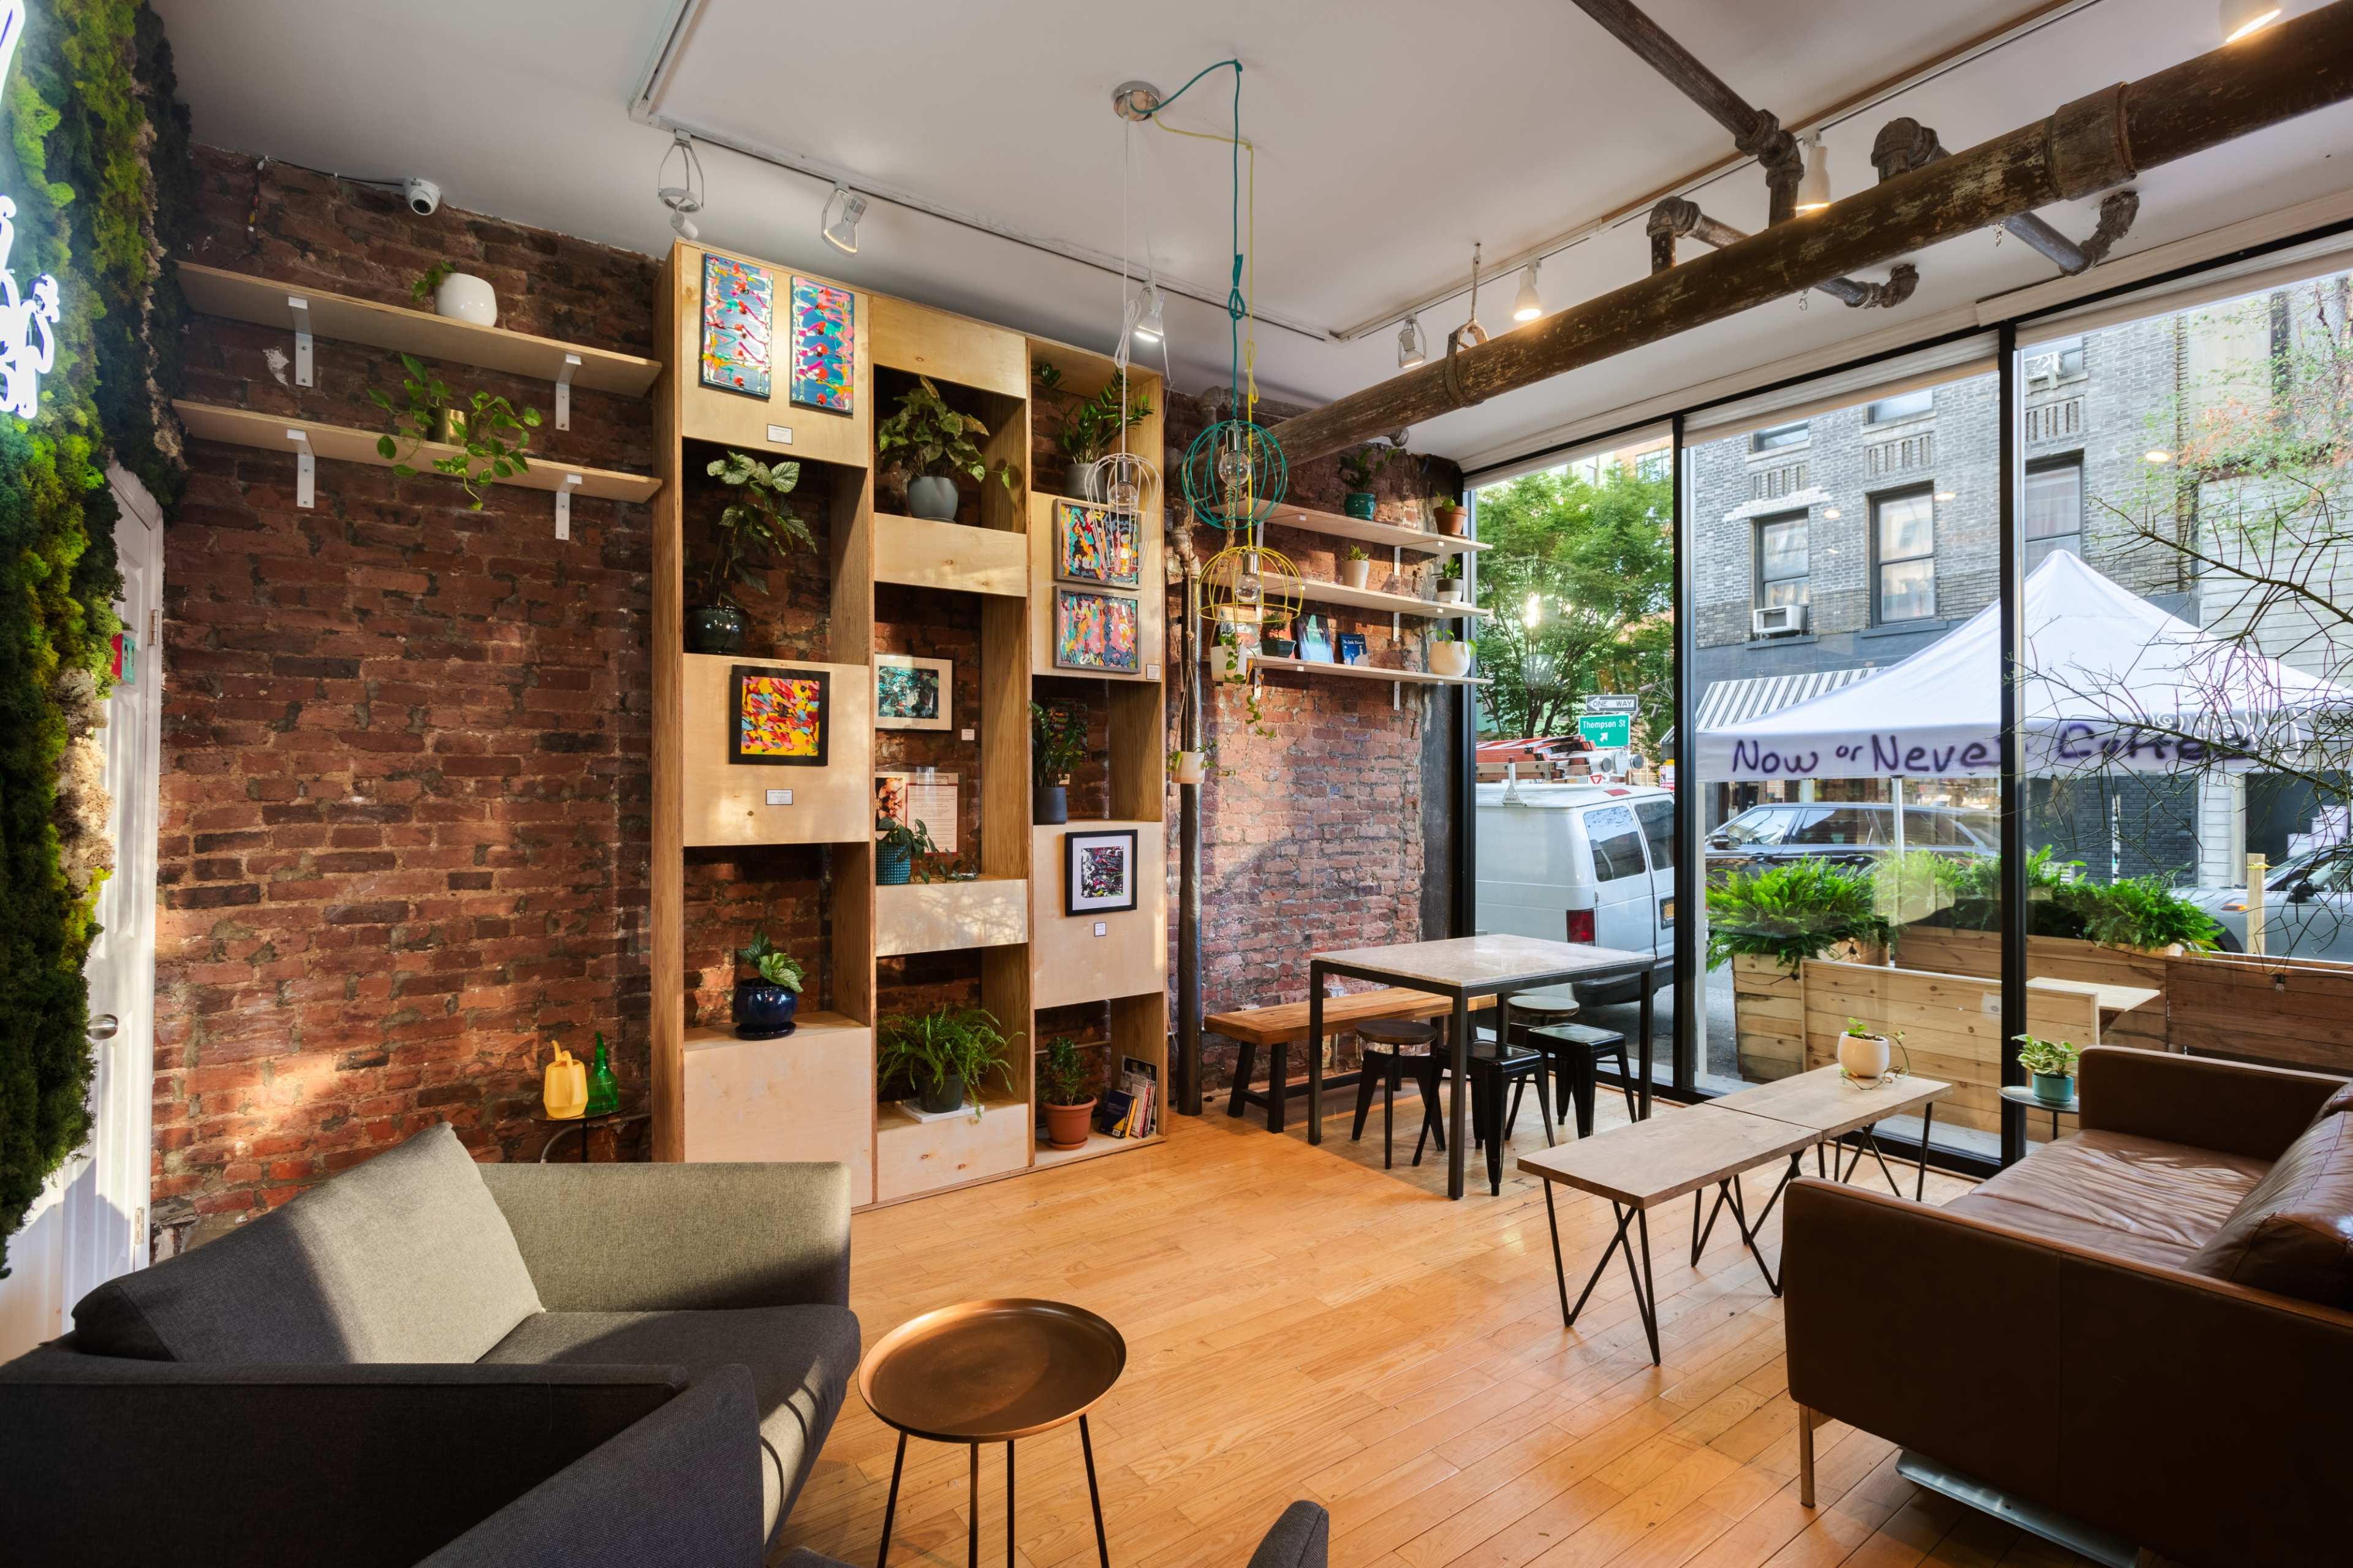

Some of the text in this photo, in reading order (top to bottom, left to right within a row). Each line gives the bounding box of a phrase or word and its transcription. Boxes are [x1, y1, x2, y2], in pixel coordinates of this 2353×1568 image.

[1583, 721, 1616, 730] Thompson
[1732, 740, 1819, 773] Now
[1836, 744, 1865, 762] or
[1872, 734, 2001, 773] Neve
